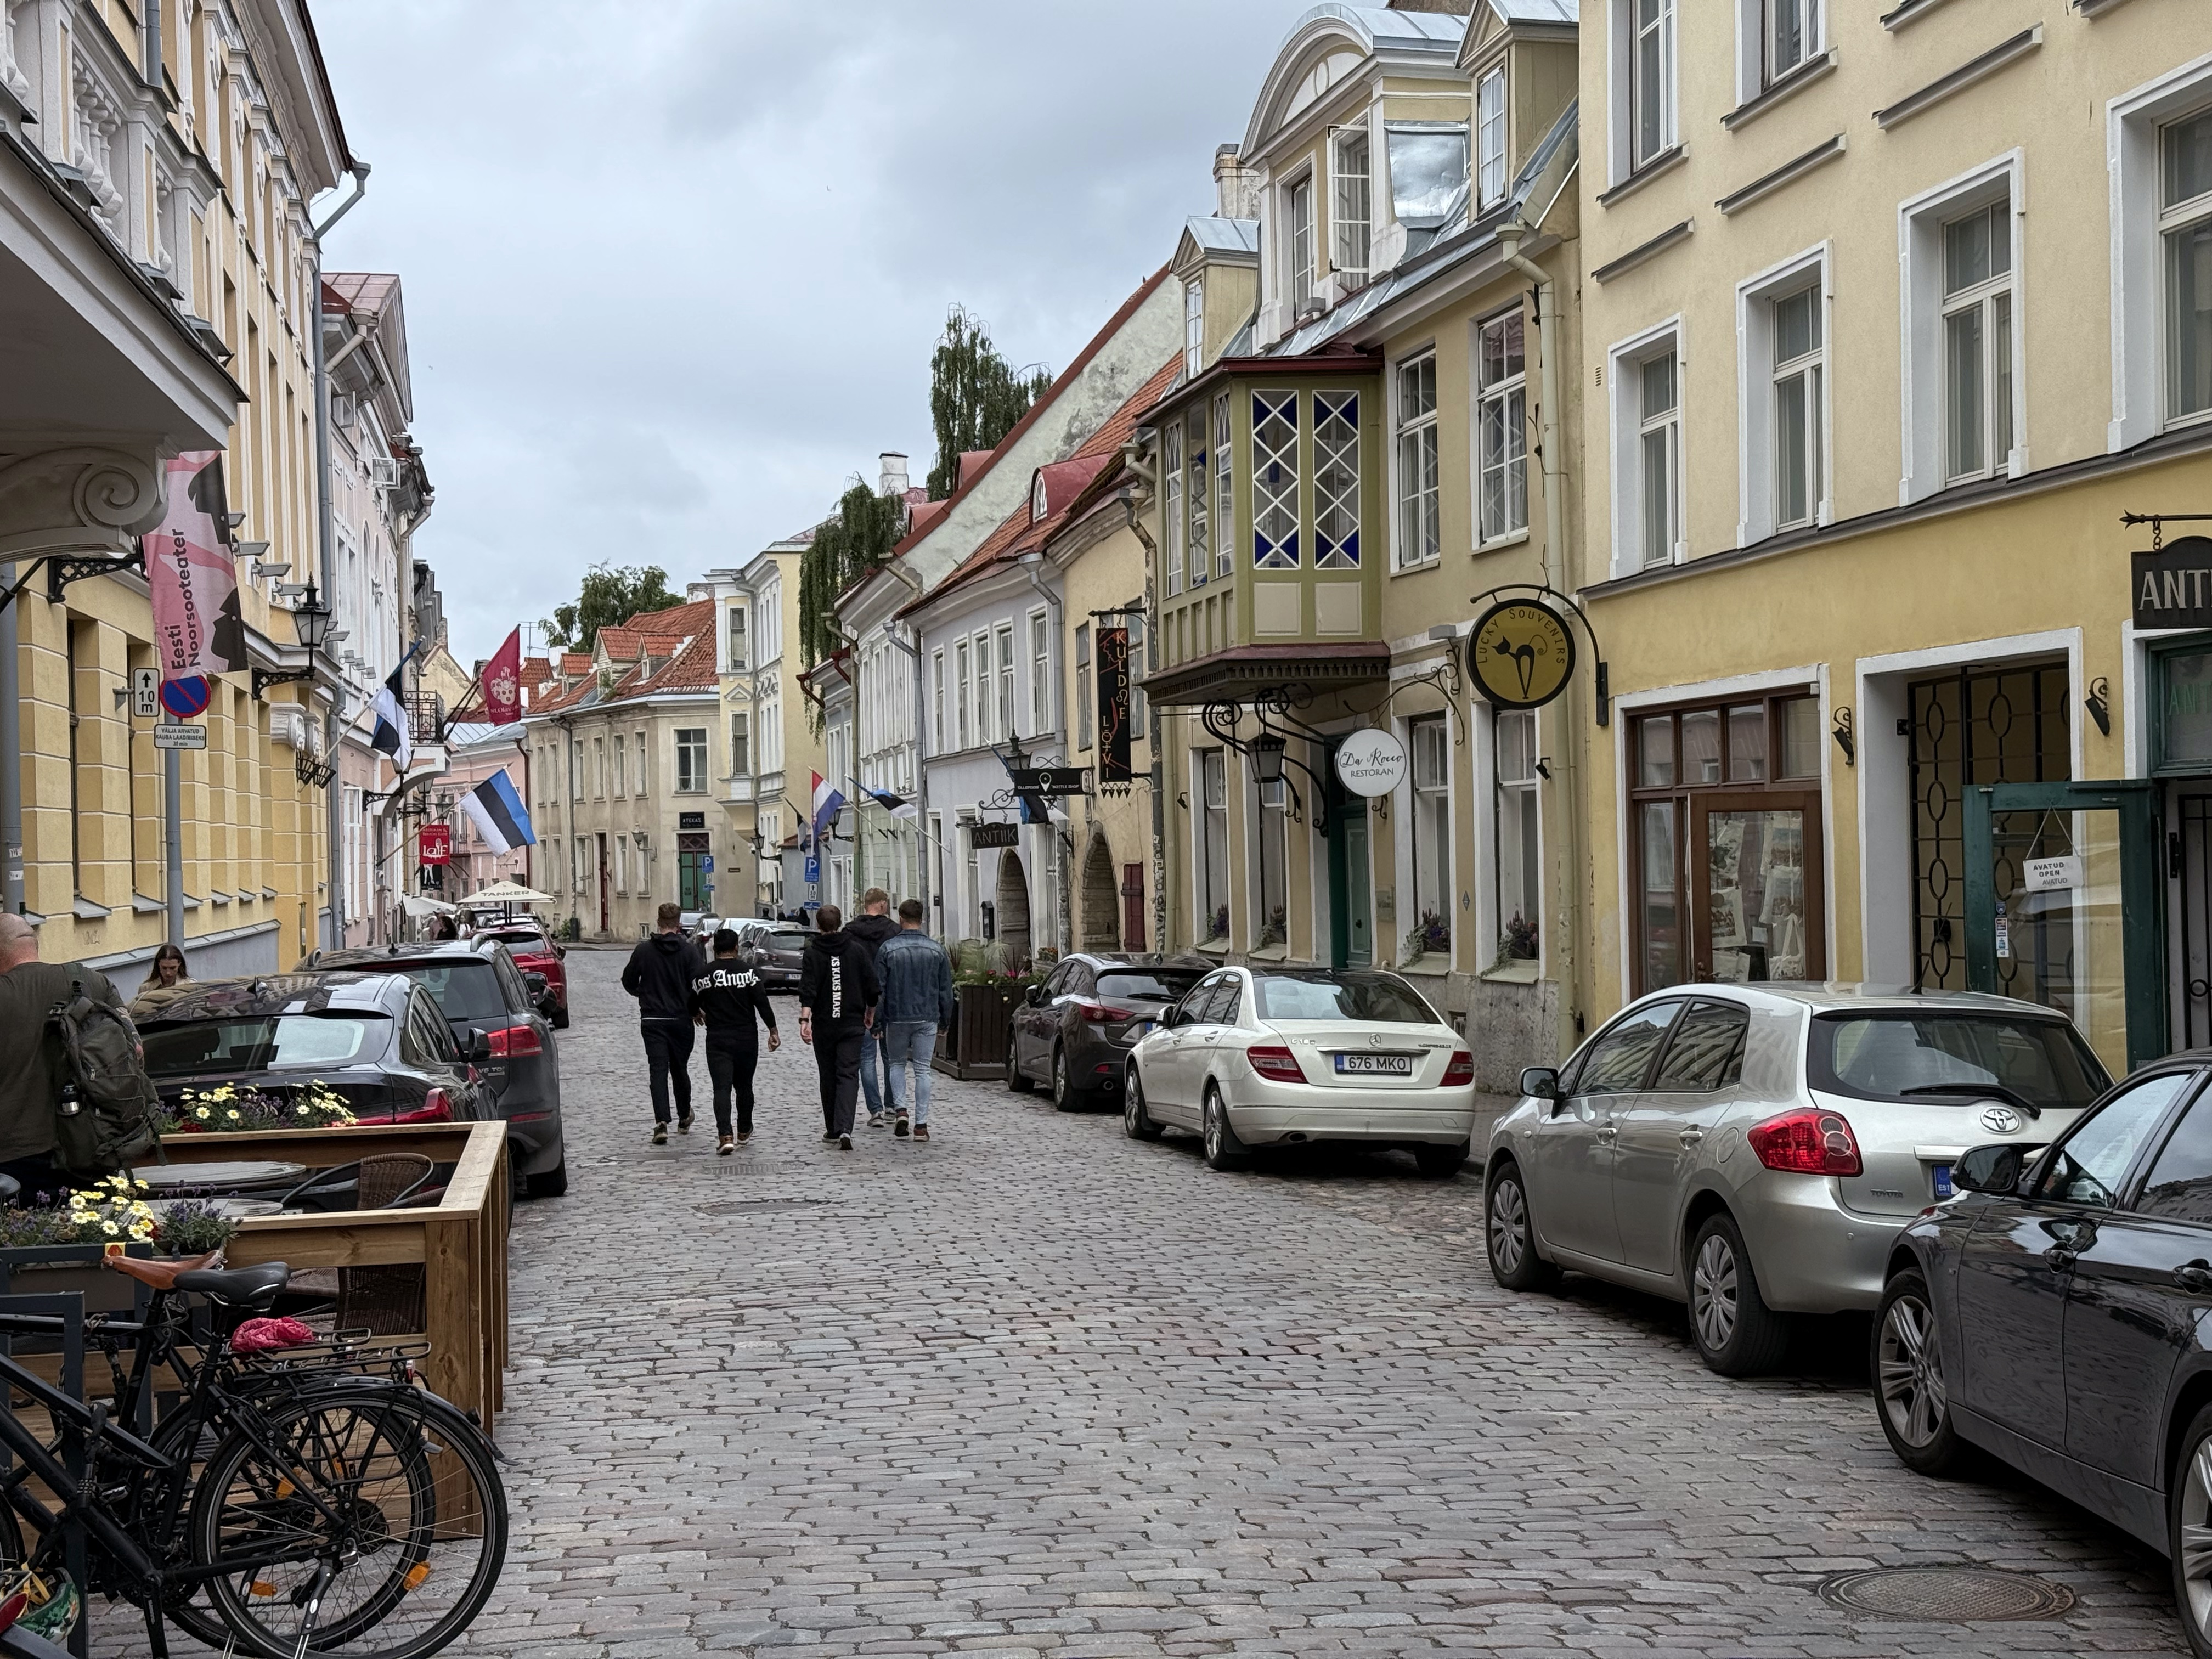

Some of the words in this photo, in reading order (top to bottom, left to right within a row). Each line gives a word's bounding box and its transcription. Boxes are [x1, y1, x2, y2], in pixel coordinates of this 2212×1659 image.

[172, 528, 201, 668] Noorsooteater
[1477, 619, 1499, 664] LUCKY
[1509, 608, 1566, 664] SOUVENIRS
[165, 625, 187, 670] Eesti
[139, 690, 155, 702] 10
[142, 704, 153, 713] m
[1339, 752, 1363, 768] Da
[1366, 747, 1403, 766] Rocco
[1351, 768, 1394, 778] RESTORAN
[973, 828, 1017, 845] ANTIIK
[704, 857, 711, 867] P
[808, 858, 817, 872] P
[2033, 862, 2064, 871] AVATUD
[2039, 870, 2060, 878] OPEN
[692, 974, 712, 996] Los
[832, 967, 841, 991] KAKS
[832, 991, 842, 1018] MAKS
[1348, 1056, 1372, 1069] 676
[1376, 1057, 1406, 1070] MKO
